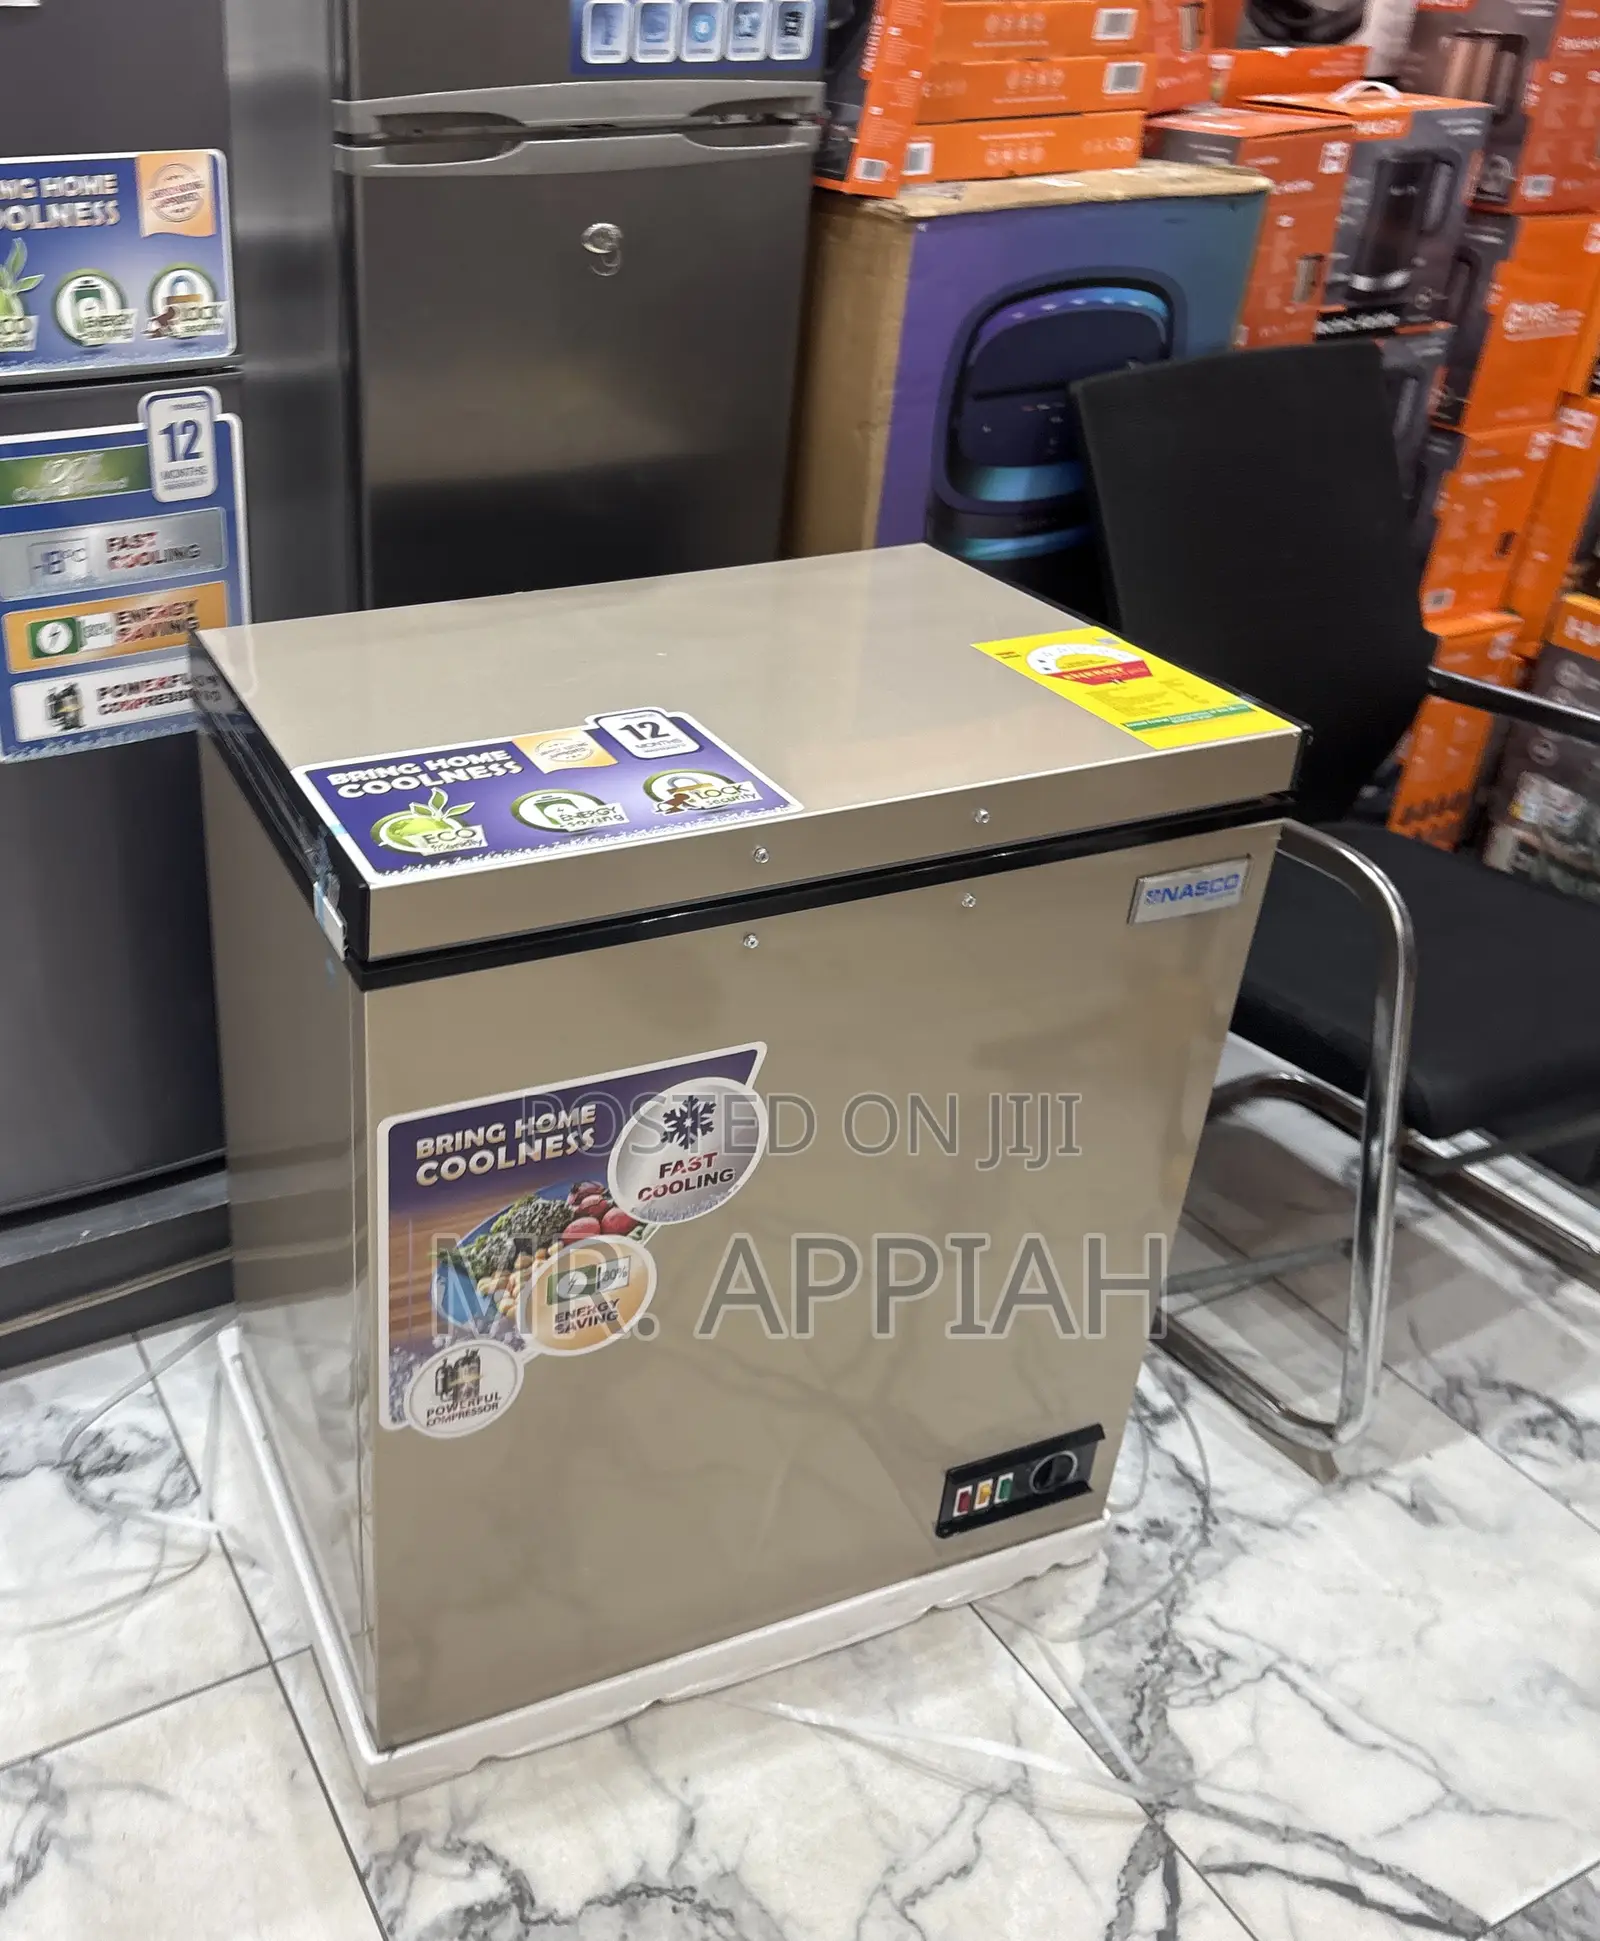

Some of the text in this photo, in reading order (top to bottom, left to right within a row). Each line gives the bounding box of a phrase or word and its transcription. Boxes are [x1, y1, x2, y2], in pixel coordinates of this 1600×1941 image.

[39, 173, 119, 198] HOME
[0, 200, 121, 231] OLNESS
[158, 420, 204, 462] 12
[106, 531, 159, 553] FAST
[107, 543, 201, 570] COOLING
[116, 599, 199, 626] ENERGY
[116, 616, 200, 643] SAVING
[619, 721, 670, 741] 12
[326, 750, 513, 786] BRING HOME
[337, 761, 525, 799] COOLNESS
[695, 784, 750, 800] LOCK
[559, 806, 618, 822] ENERGY
[422, 827, 477, 845] ECO
[1160, 873, 1240, 903] NASCO
[416, 1104, 598, 1160] BRING HOME
[416, 1128, 598, 1187] COOLNESS
[658, 1152, 719, 1180] FAST
[637, 1167, 735, 1203] COOLING
[554, 1298, 620, 1322] ENERGY
[554, 1311, 619, 1335] SAVING
[426, 1392, 502, 1419] POWERFUL
[426, 1402, 500, 1428] COMPRESSOR
